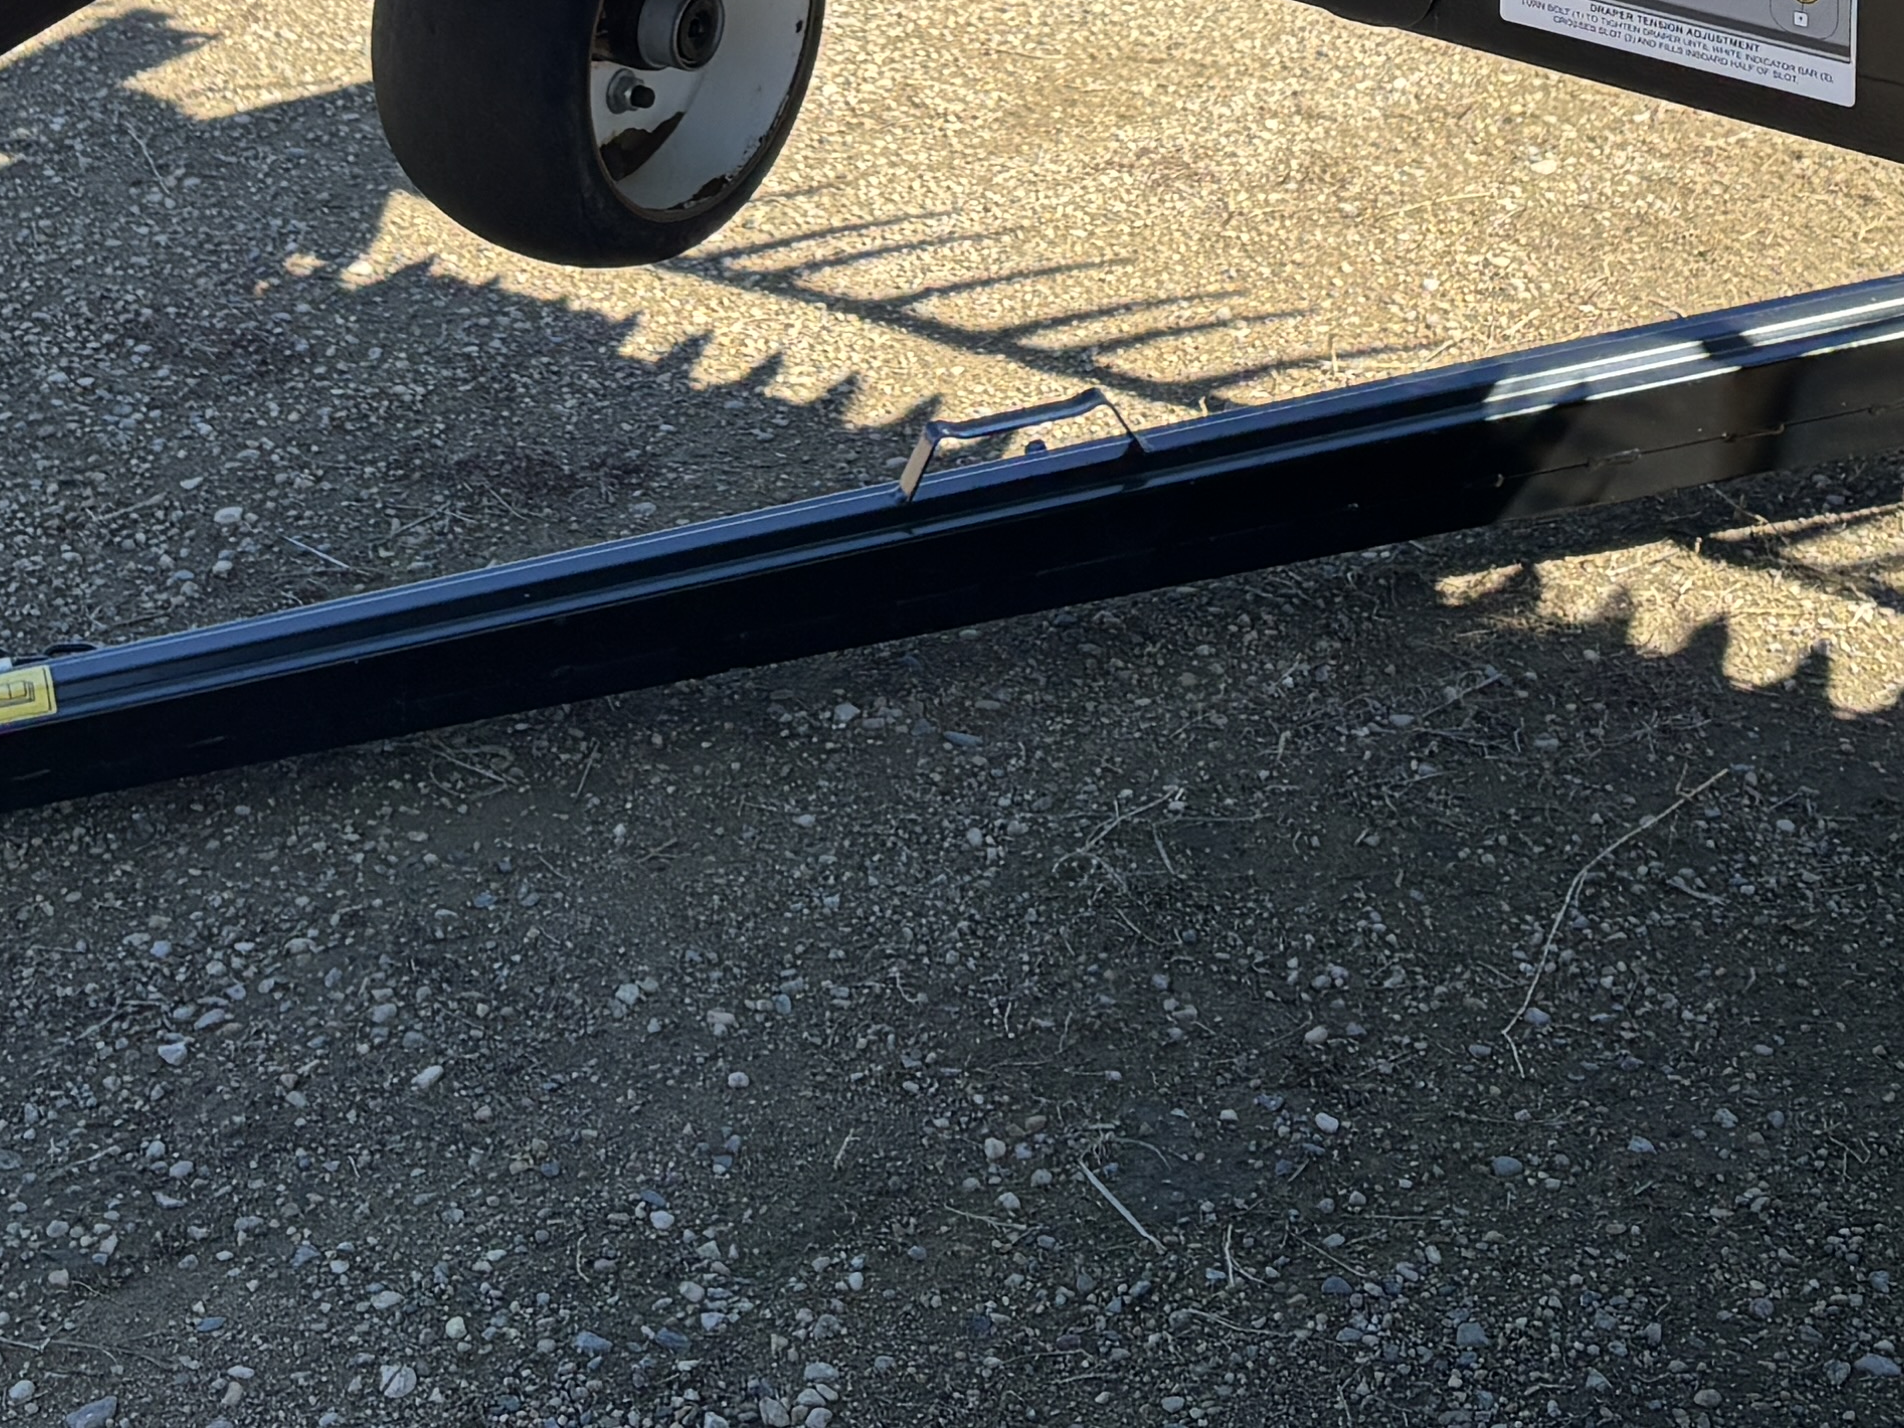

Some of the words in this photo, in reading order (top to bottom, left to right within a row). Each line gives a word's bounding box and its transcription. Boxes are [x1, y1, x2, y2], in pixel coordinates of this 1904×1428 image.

[1547, 3, 1570, 16] BOLT
[1586, 13, 1598, 23] TO
[1601, 17, 1641, 34] TIGHTEN
[1642, 28, 1680, 44] DRAPER
[1712, 45, 1741, 60] WHITE
[1746, 53, 1796, 73] INDICATOR
[1798, 66, 1818, 79] BAR
[1553, 15, 1596, 32] CROSSES
[1598, 26, 1621, 39] SLOT
[1637, 36, 1656, 48] AND
[1658, 41, 1683, 54] FILLS
[1685, 50, 1728, 66] INBOARD
[1756, 66, 1769, 76] OF
[1590, 4, 1633, 22] DRAPER
[1637, 15, 1683, 34] TENSION
[1687, 28, 1760, 52] ADJUSTMENT
